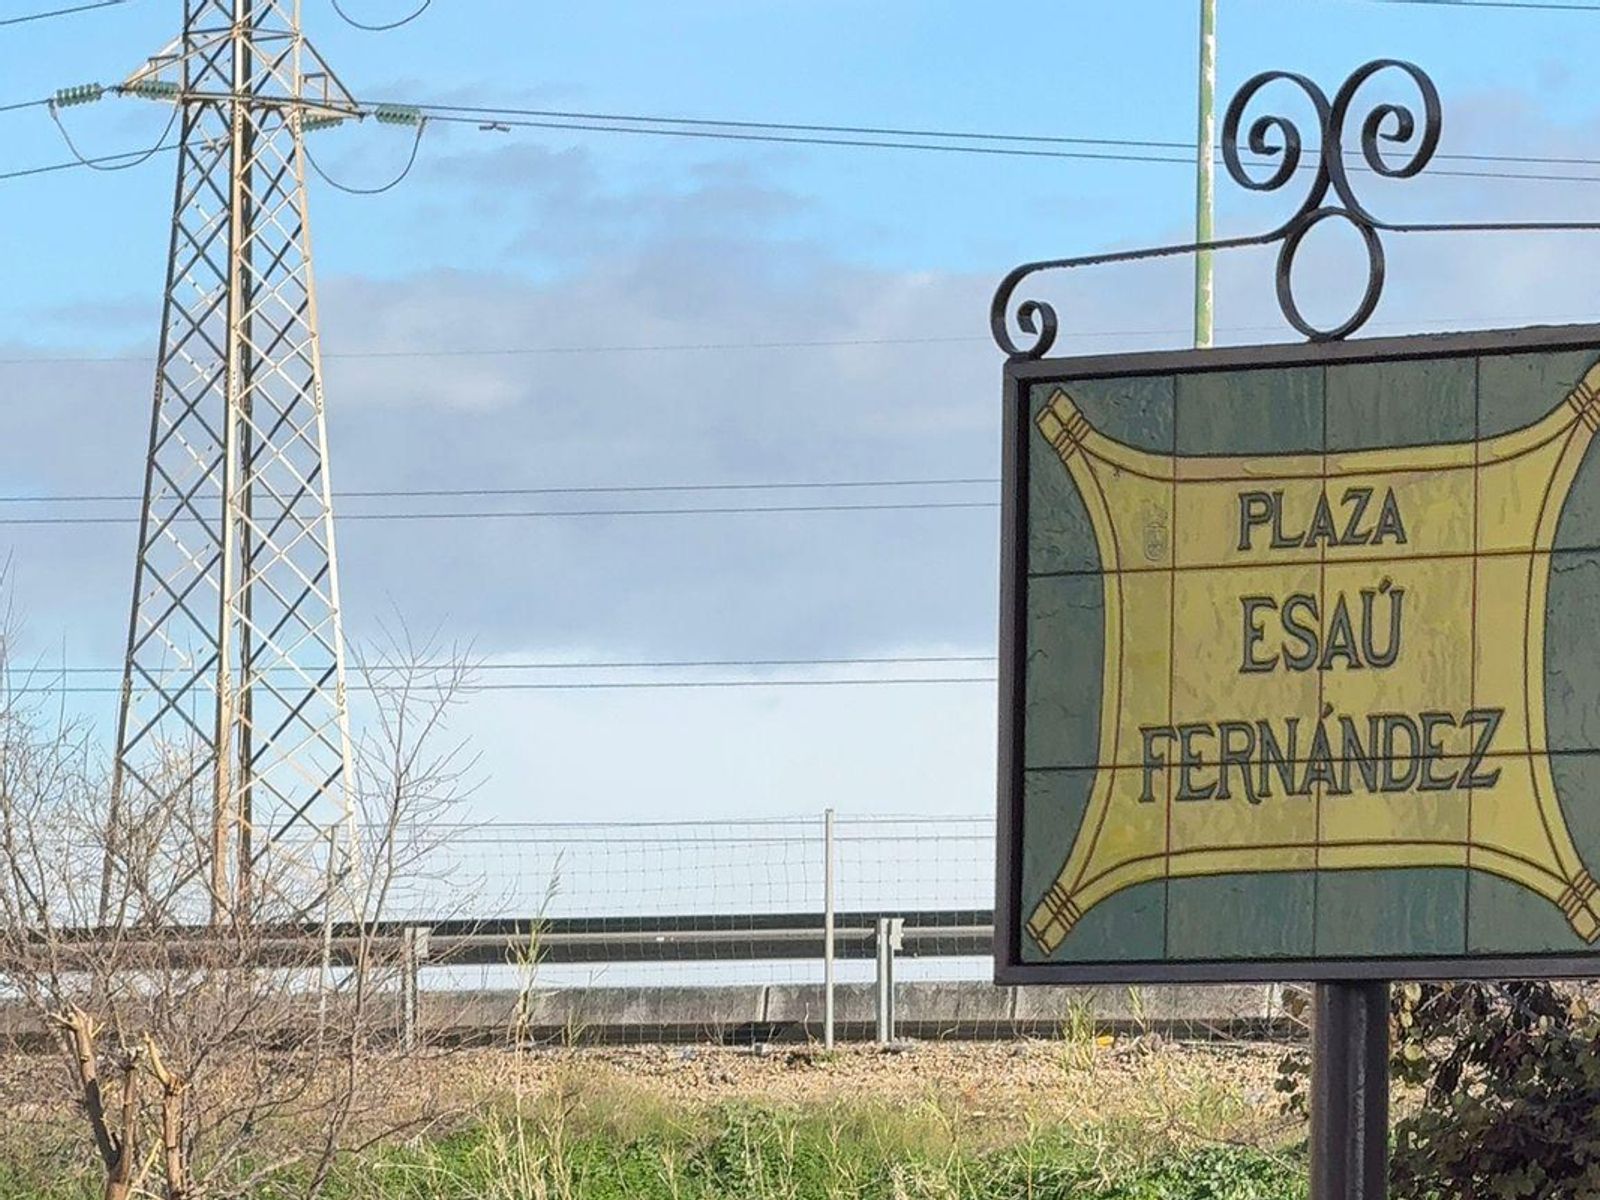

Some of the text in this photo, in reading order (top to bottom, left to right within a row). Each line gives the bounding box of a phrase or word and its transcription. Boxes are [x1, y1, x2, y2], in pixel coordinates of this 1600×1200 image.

[1237, 486, 1408, 551] PLAZA
[1239, 576, 1406, 674] ESAÚ
[1137, 703, 1507, 806] FERNÁNDEZ
